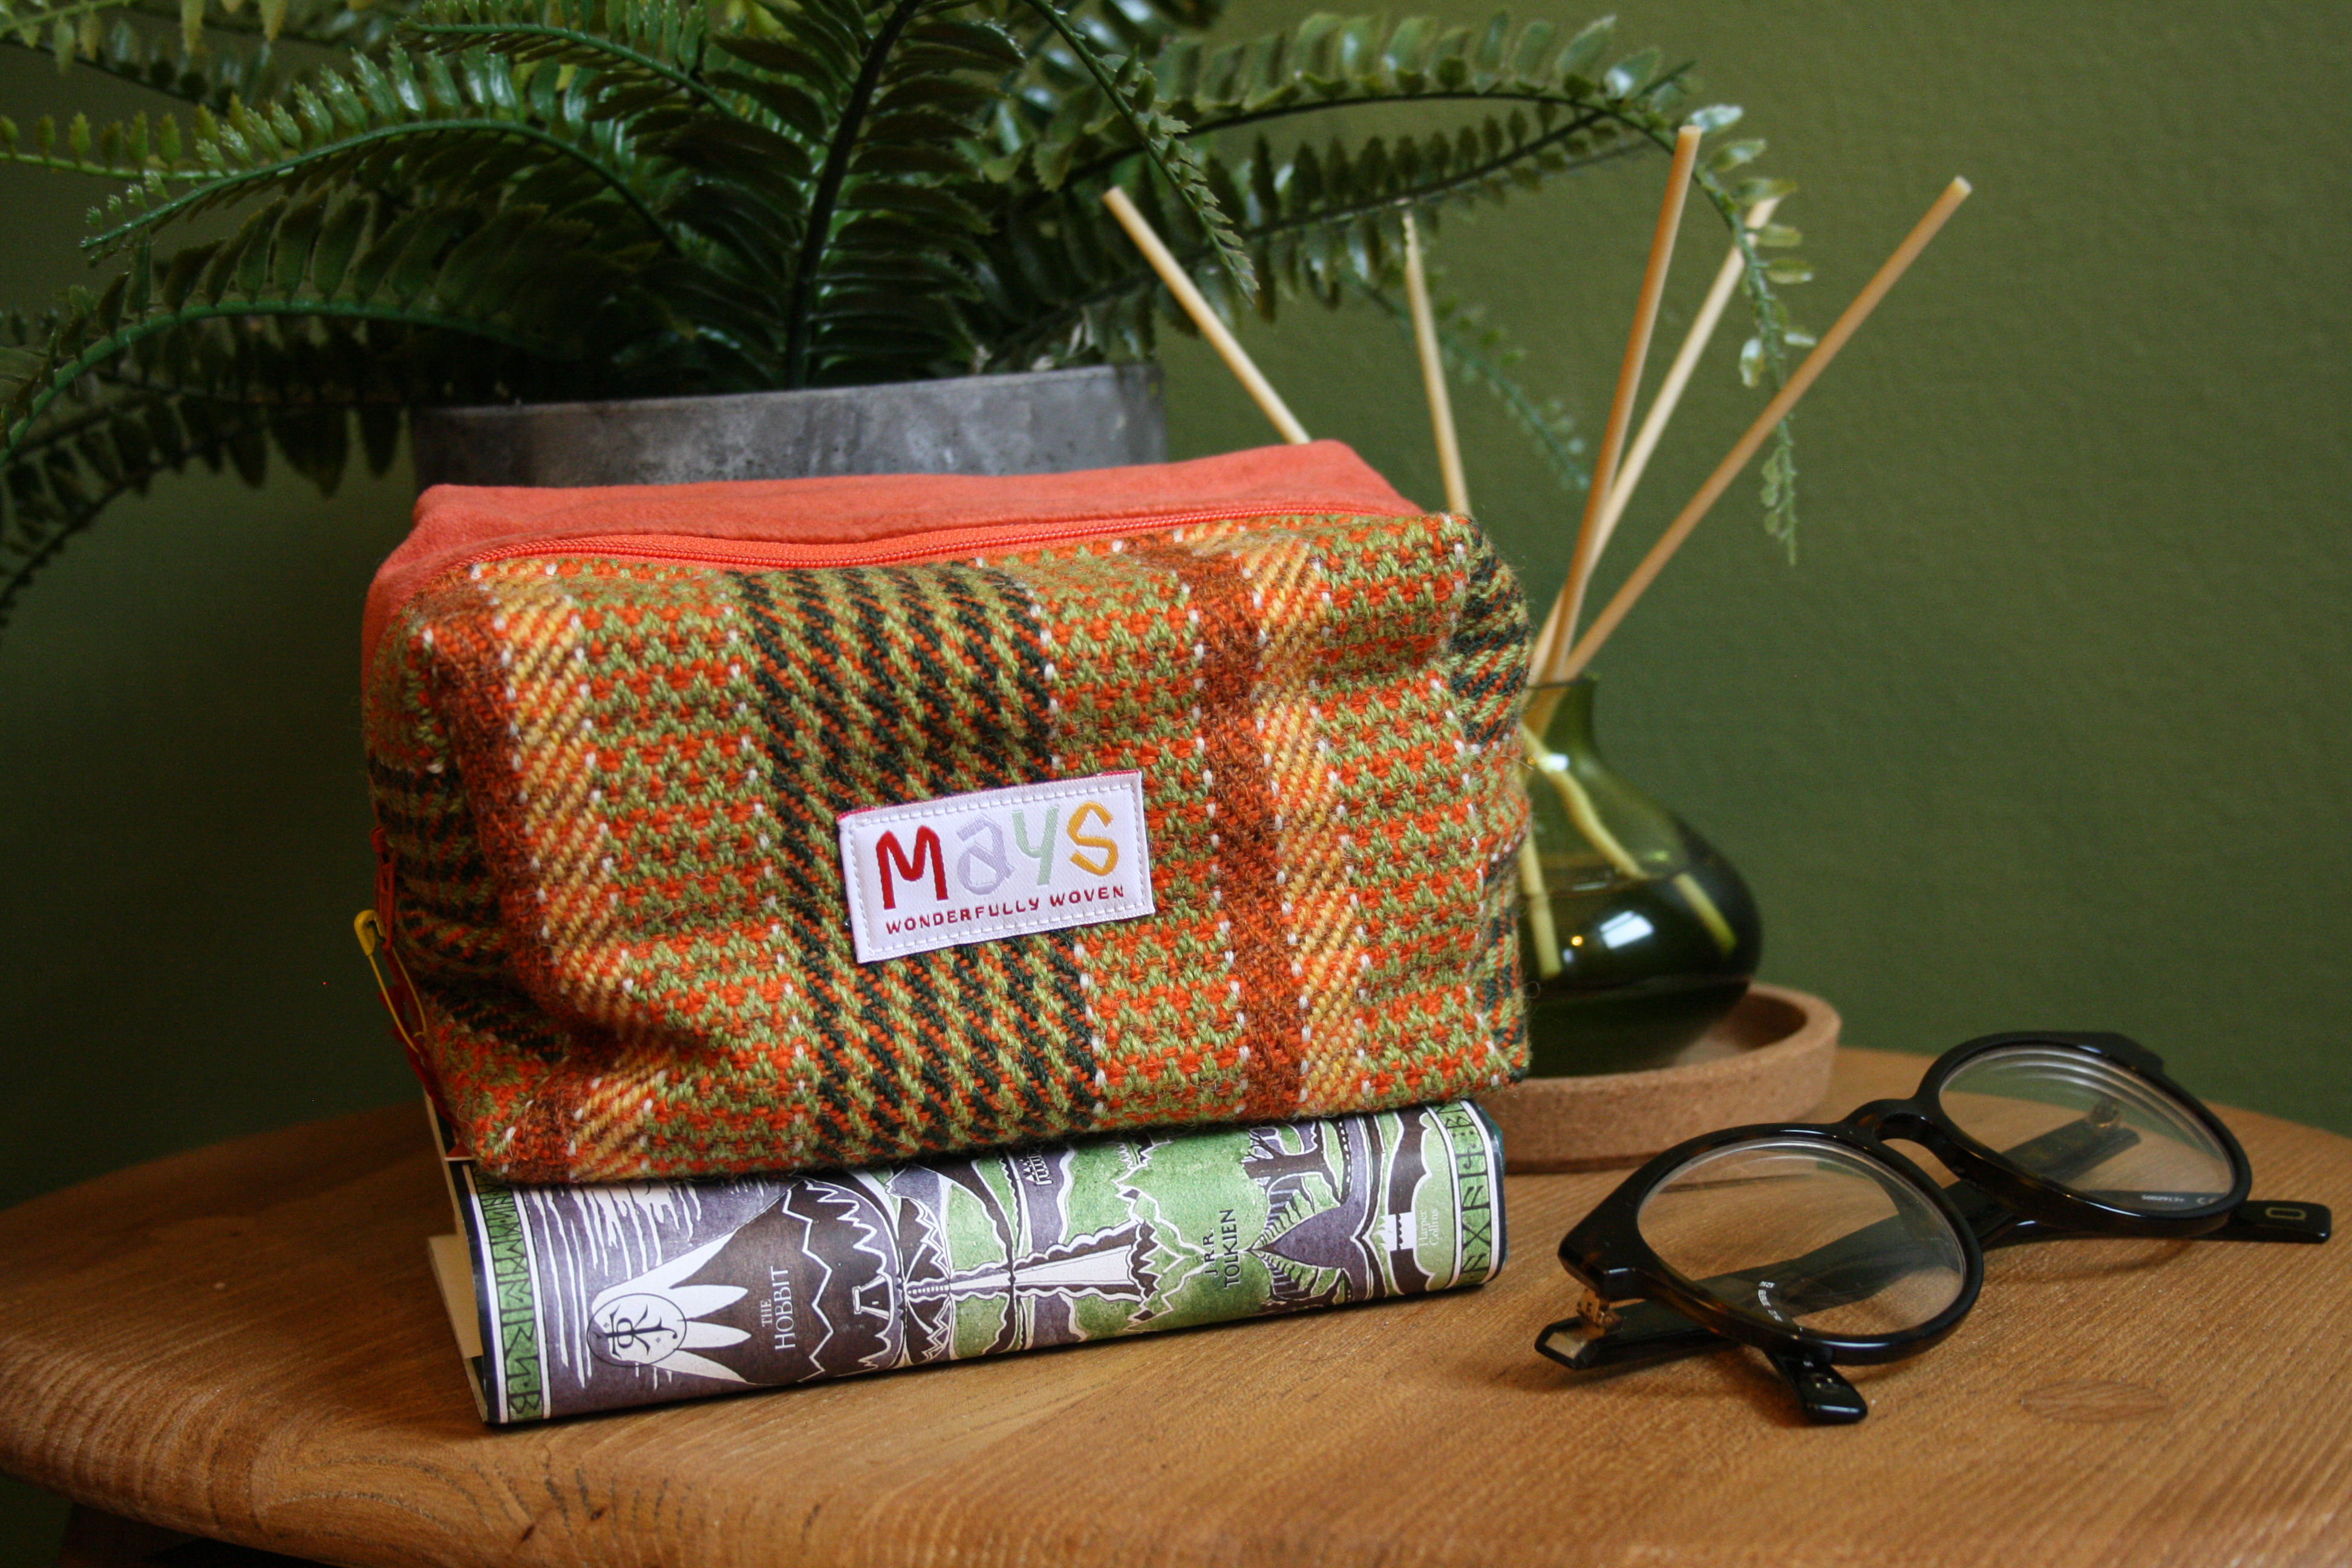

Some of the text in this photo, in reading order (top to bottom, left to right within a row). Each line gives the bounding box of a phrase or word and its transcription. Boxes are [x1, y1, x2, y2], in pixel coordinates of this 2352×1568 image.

[886, 885, 1125, 935] WONDERFULLY WOVEN
[1203, 1227, 1218, 1276] J.R.R.
[1220, 1209, 1240, 1289] TOLKIEN
[1418, 1210, 1431, 1246] Harper
[1428, 1209, 1439, 1246] Collins
[760, 1299, 773, 1327] THE
[770, 1266, 795, 1350] HOBBIT
